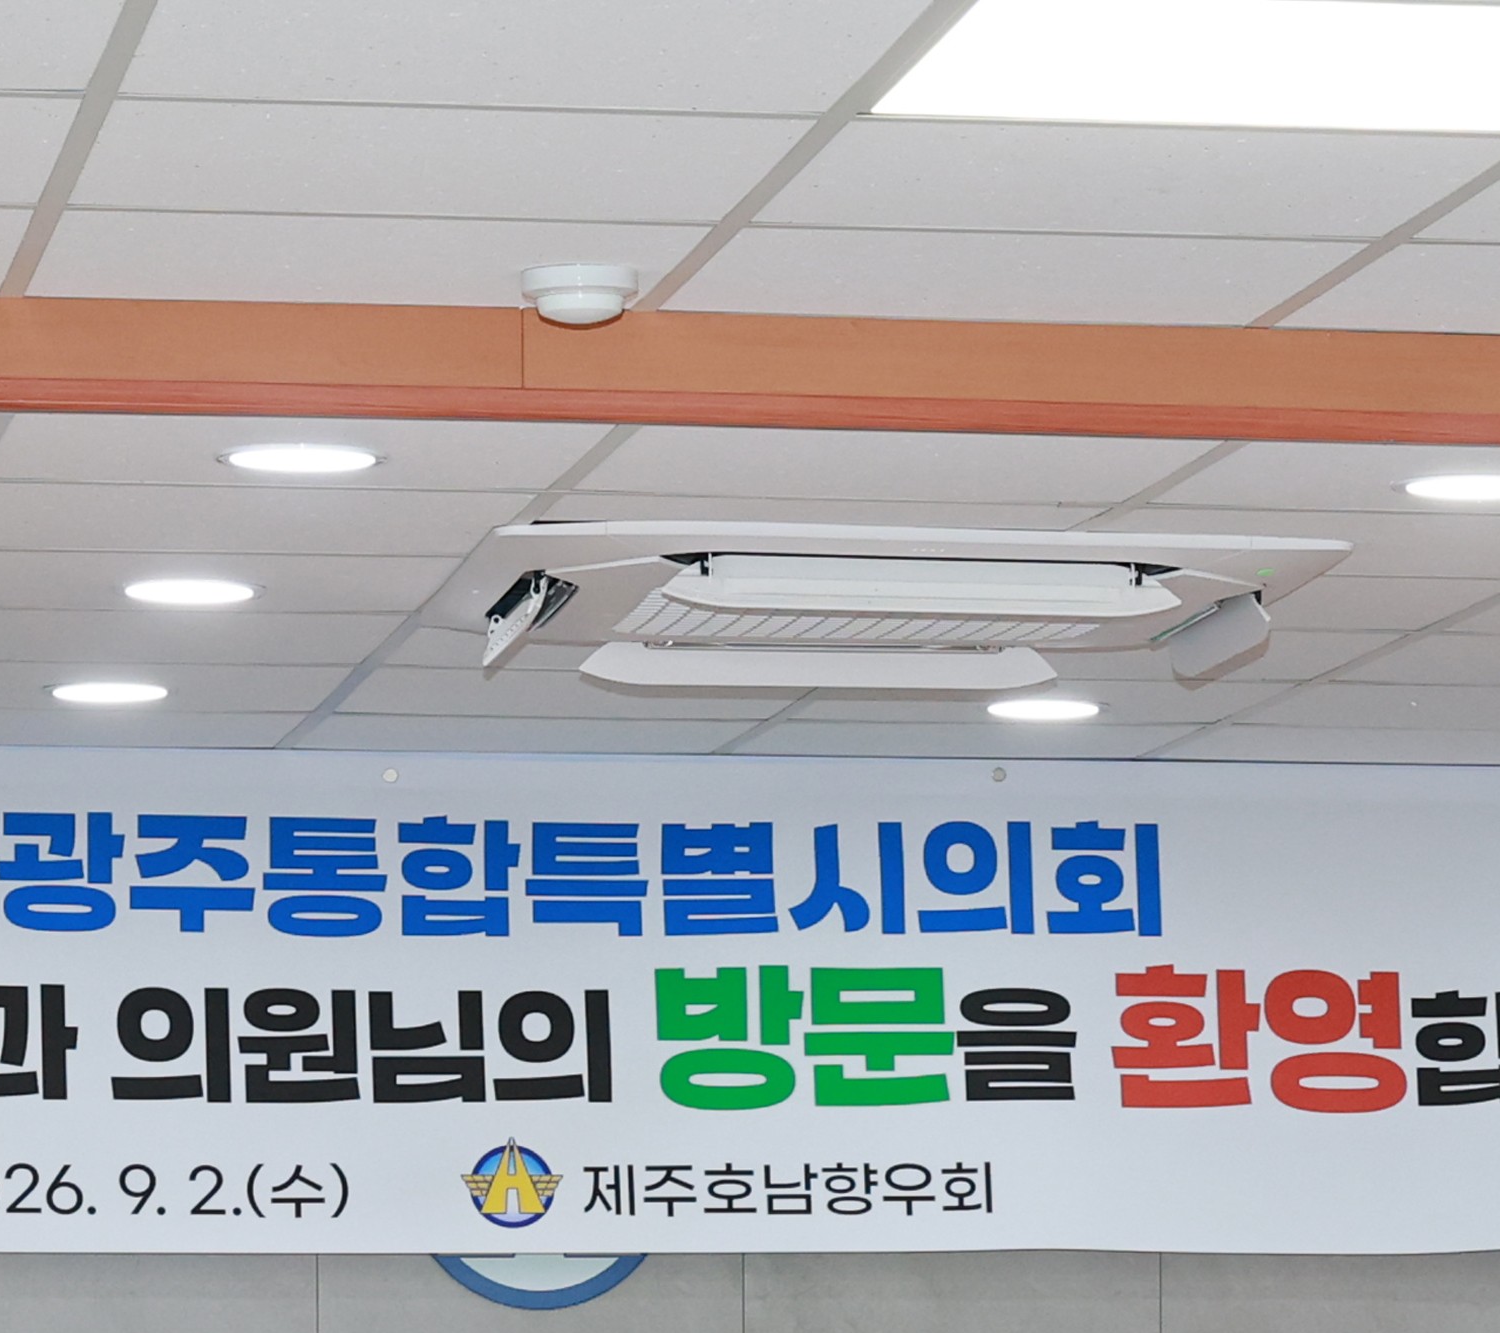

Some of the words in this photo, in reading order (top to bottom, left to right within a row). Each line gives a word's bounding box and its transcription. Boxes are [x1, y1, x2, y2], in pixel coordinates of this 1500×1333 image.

[110, 986, 613, 1104] 의원님의
[654, 964, 1078, 1112] 방문을
[583, 1161, 994, 1218] 제주호남향우회
